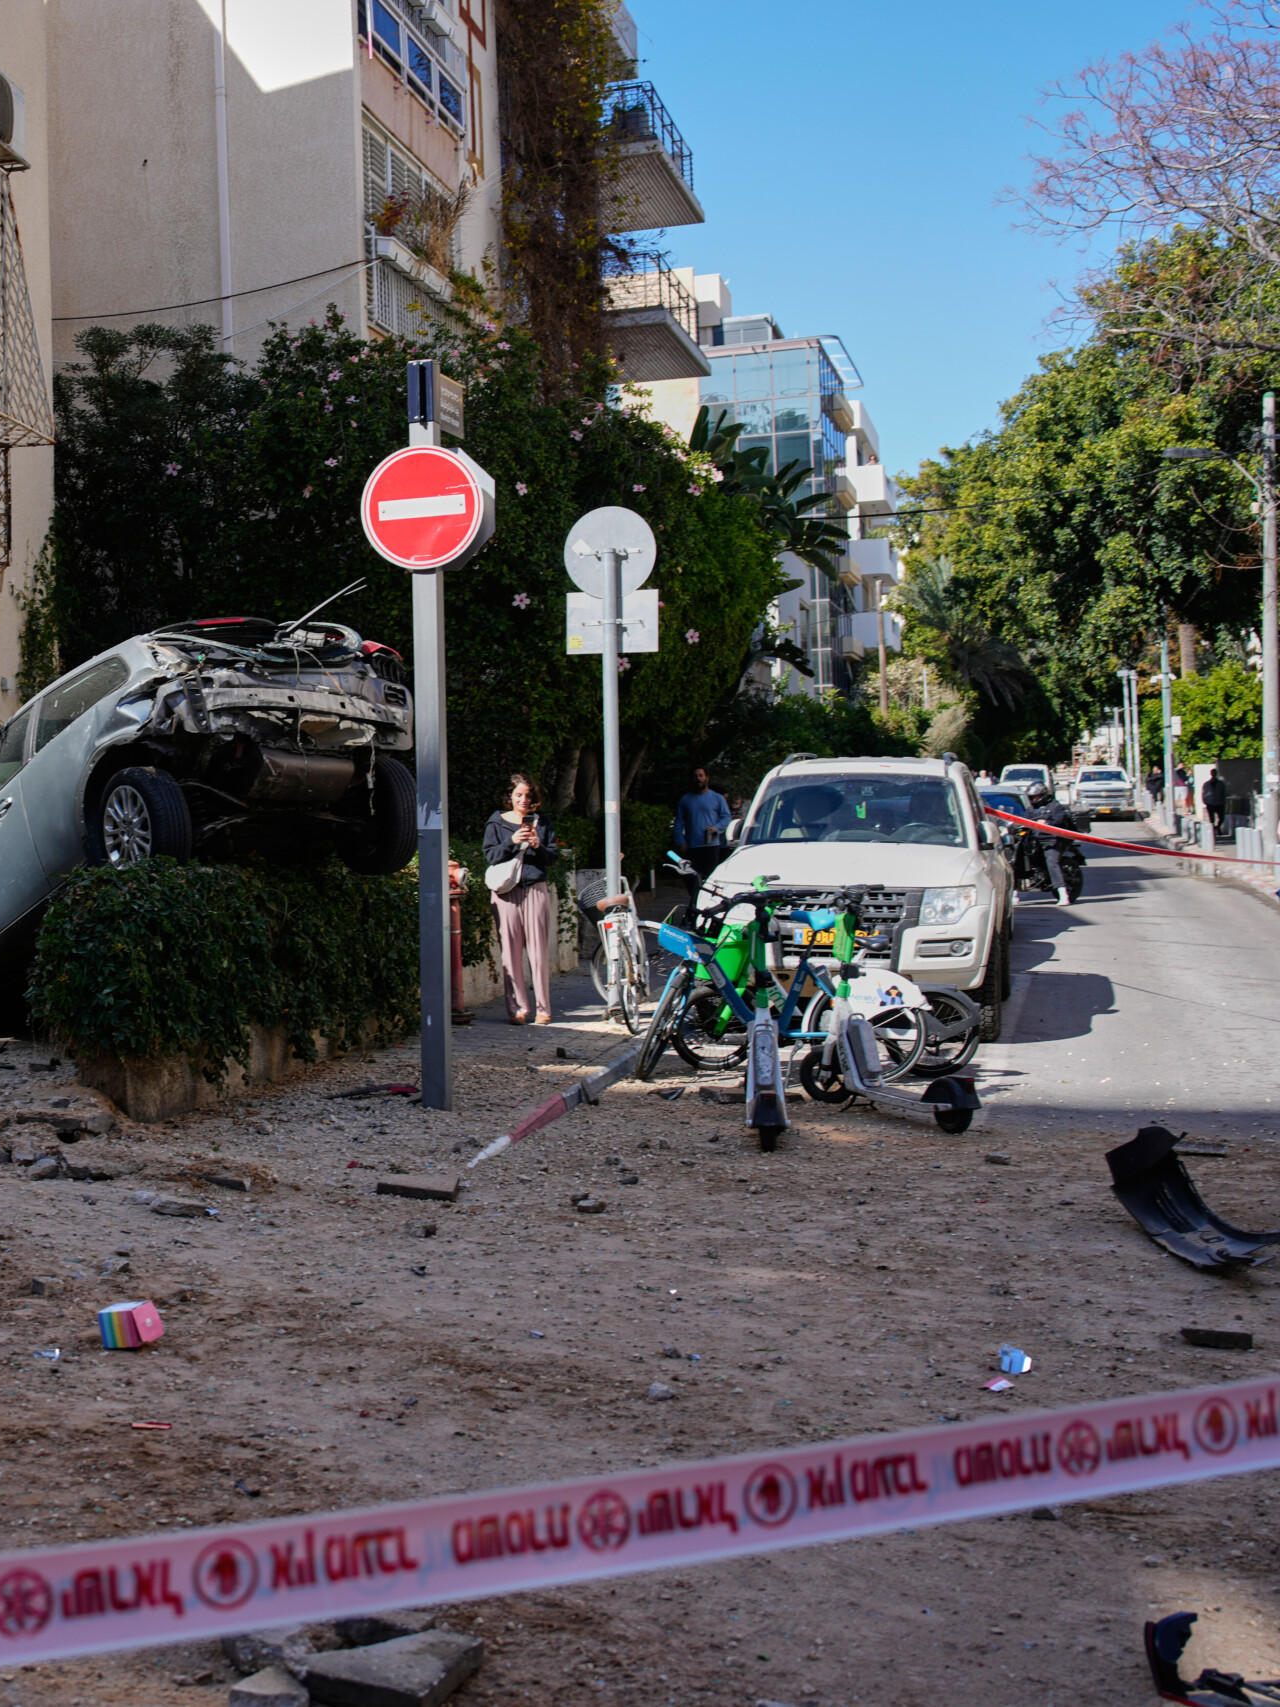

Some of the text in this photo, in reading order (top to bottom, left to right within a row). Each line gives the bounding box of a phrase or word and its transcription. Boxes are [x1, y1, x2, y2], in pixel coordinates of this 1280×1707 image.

[62, 1558, 186, 1618] ישראל
[452, 1504, 570, 1565] משטרת
[637, 1482, 740, 1536] ישראל
[953, 1431, 1052, 1487] משטרת
[1106, 1411, 1191, 1462] ישראל
